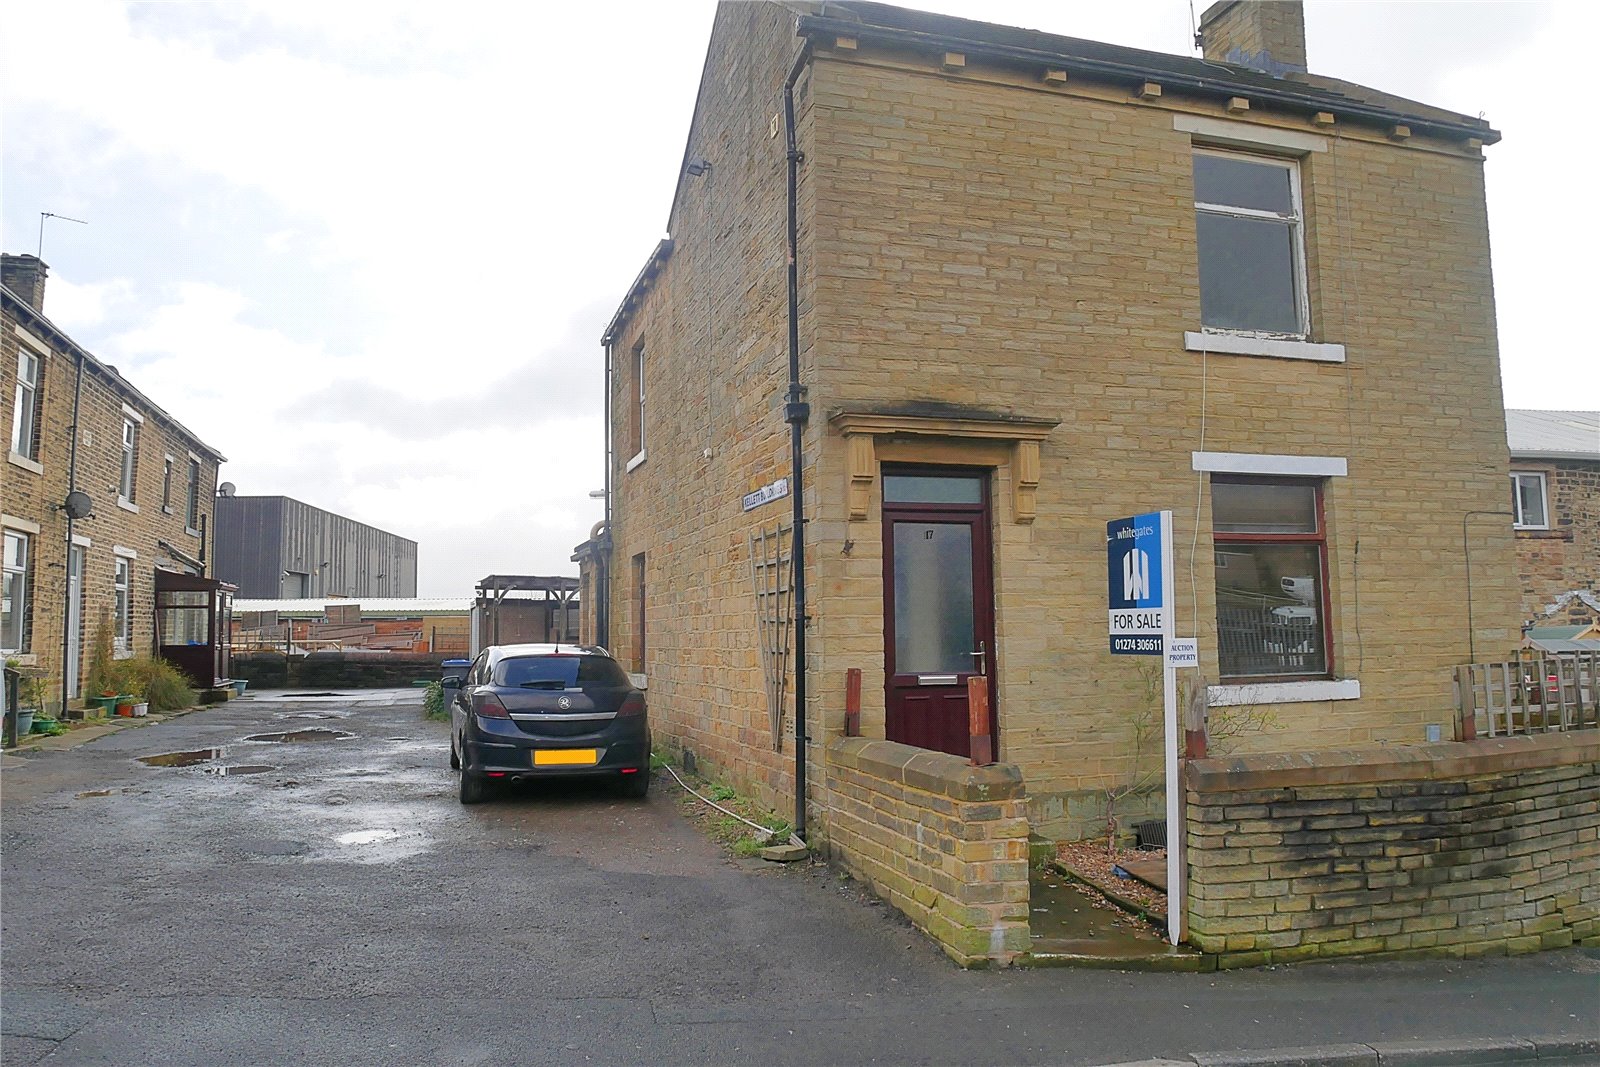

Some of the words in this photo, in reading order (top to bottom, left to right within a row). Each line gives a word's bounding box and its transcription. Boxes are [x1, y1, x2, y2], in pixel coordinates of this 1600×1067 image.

[926, 530, 934, 540] 17
[1116, 525, 1153, 540] whitegates
[1113, 614, 1133, 629] FOR
[1136, 613, 1162, 629] SALE
[1115, 638, 1136, 650] 01274
[1136, 638, 1162, 651] 306611
[1171, 644, 1194, 652] AUCTION
[1169, 653, 1197, 661] PROPERTY
